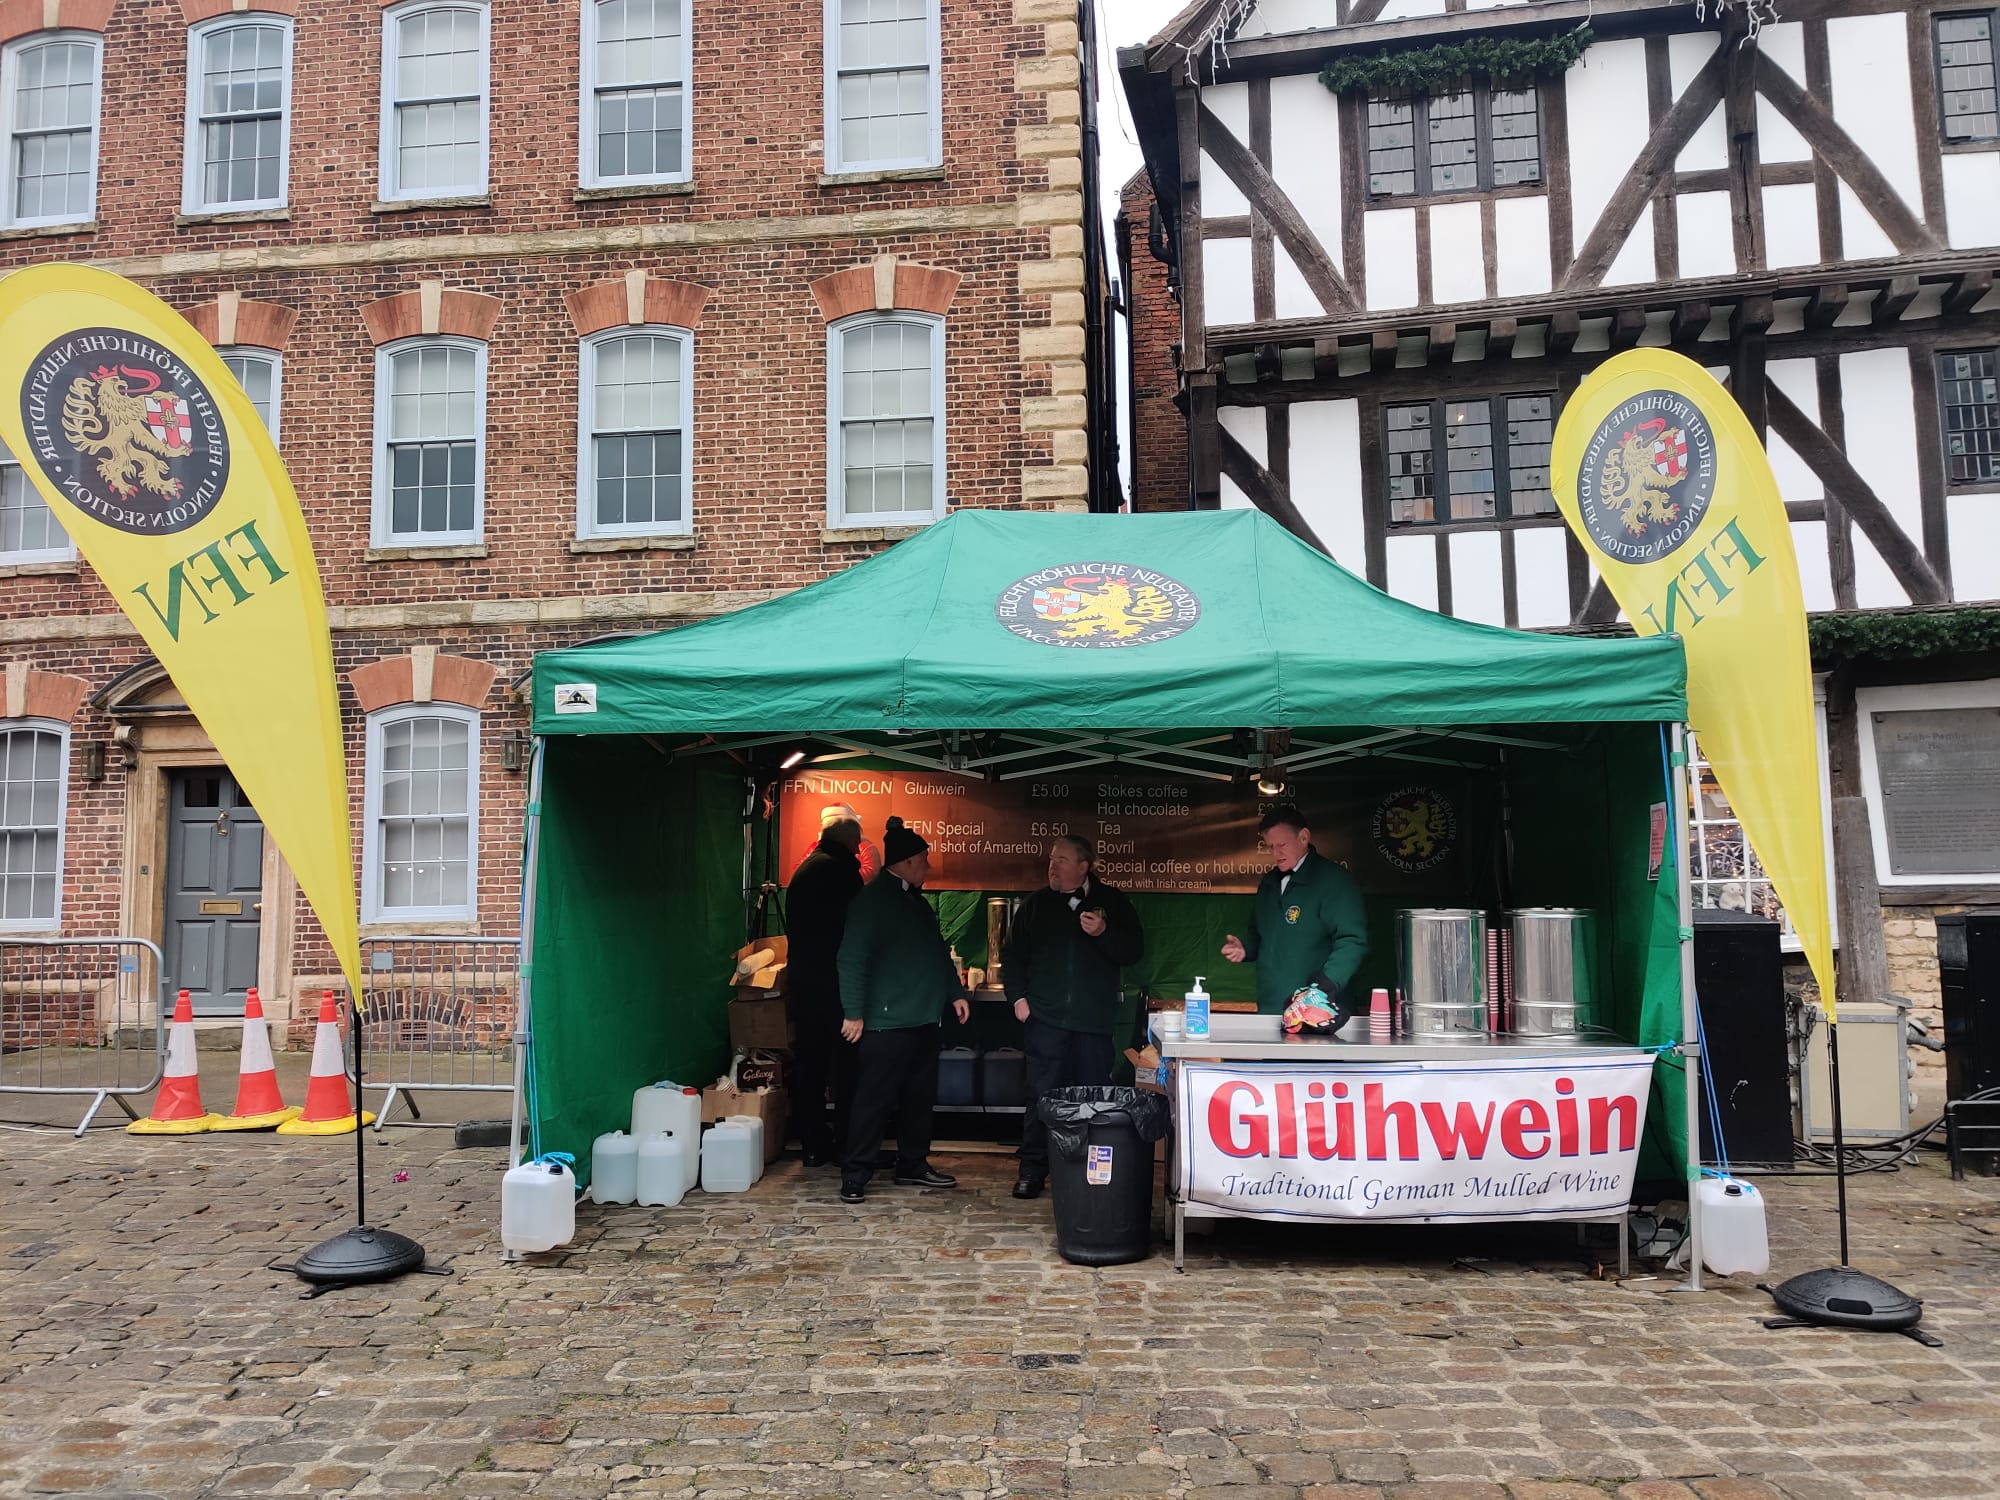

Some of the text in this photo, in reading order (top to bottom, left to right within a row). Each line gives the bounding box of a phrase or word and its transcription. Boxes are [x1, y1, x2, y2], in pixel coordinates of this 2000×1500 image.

[999, 583, 1030, 617] FEUCHT
[1007, 623, 1183, 648] LINCOLN SECTION
[784, 780, 893, 795] FFN LINCOLN
[904, 781, 1069, 798] Gluhwein £5.00
[1098, 784, 1188, 798] Stokes coffee
[1097, 803, 1190, 816] Hot chocolate
[904, 820, 1069, 838] FFN Special £6.50
[1097, 821, 1121, 835] Tea
[940, 841, 966, 854] shot
[969, 840, 980, 853] of
[983, 840, 1043, 857] Amaretto)
[1097, 840, 1135, 854] Bovril
[1097, 859, 1146, 876] Special
[1150, 860, 1191, 874] coffee
[1195, 863, 1210, 874] or
[1213, 860, 1235, 874] hot
[1136, 877, 1155, 889] with
[1157, 878, 1176, 889] Irish
[1179, 879, 1212, 891] cream)
[743, 1069, 775, 1082] Galaxy
[1207, 1077, 1638, 1162] Glühwein
[1221, 1169, 1622, 1210] Traditional German Mulled Wine
